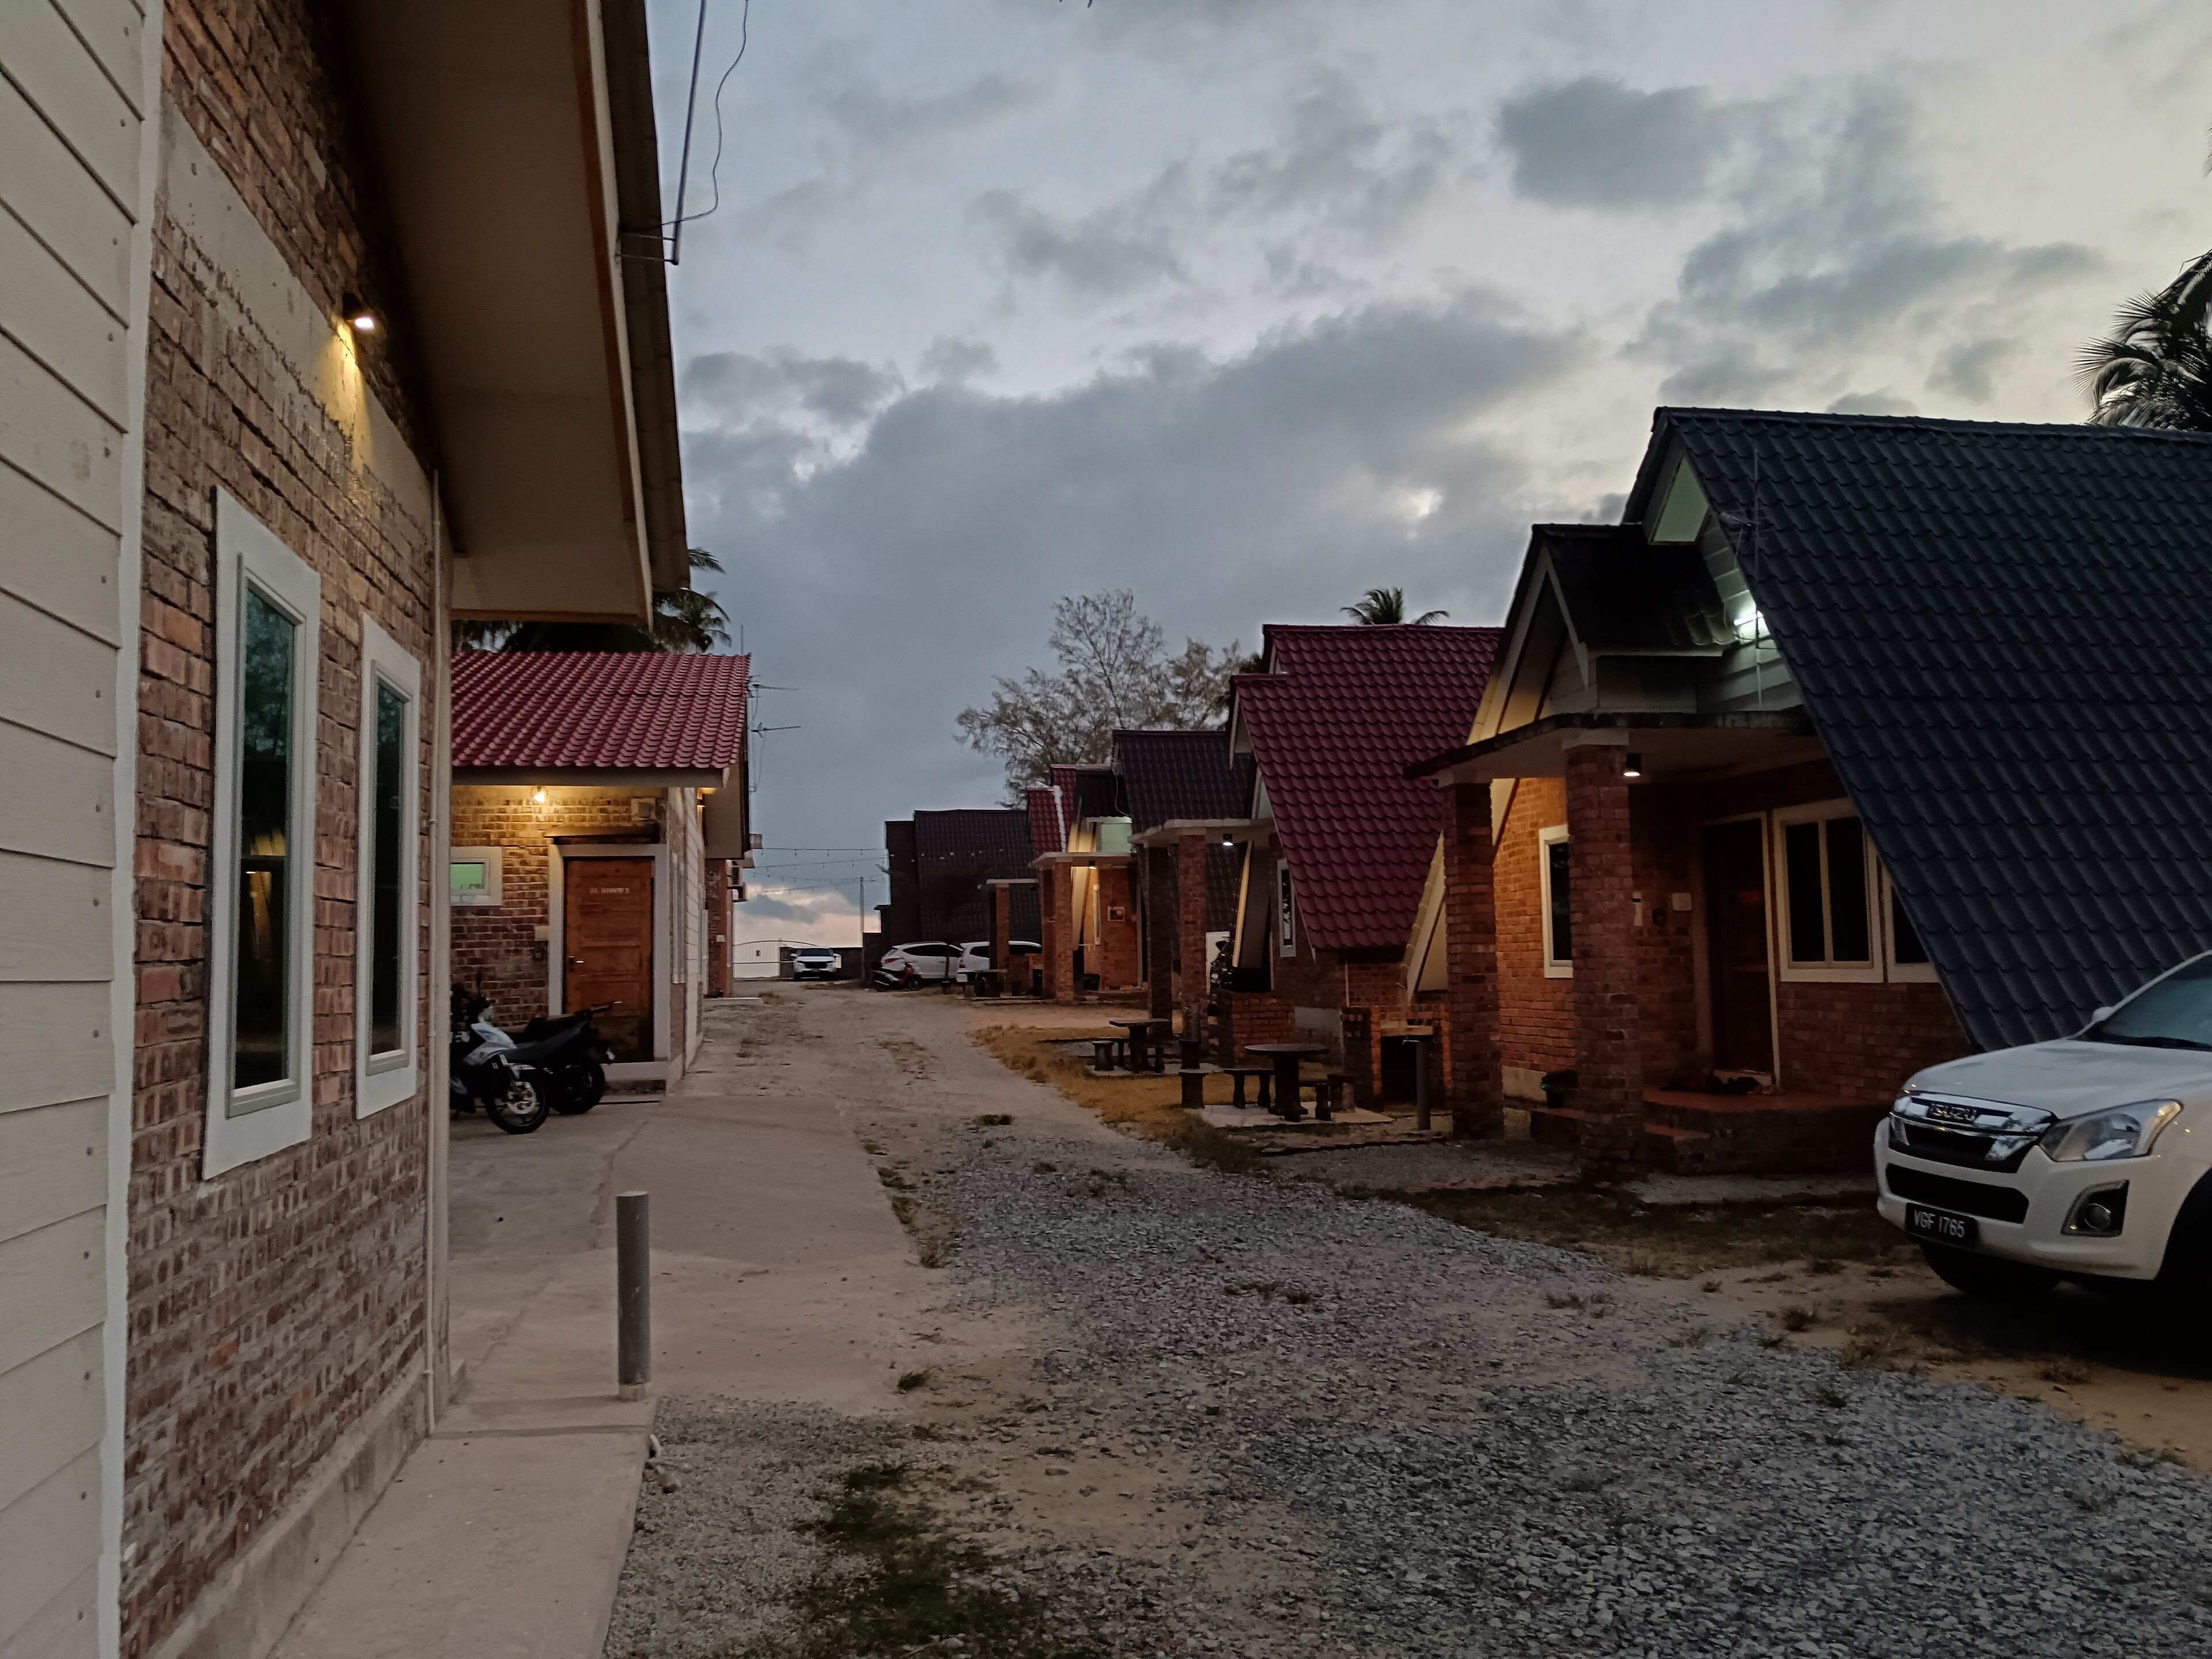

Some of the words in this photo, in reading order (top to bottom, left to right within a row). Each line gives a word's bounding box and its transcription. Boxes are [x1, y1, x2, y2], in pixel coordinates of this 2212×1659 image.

[1929, 1103, 1977, 1121] ISUZU
[1914, 1210, 1936, 1230] VGF
[1940, 1215, 1965, 1238] 1765
